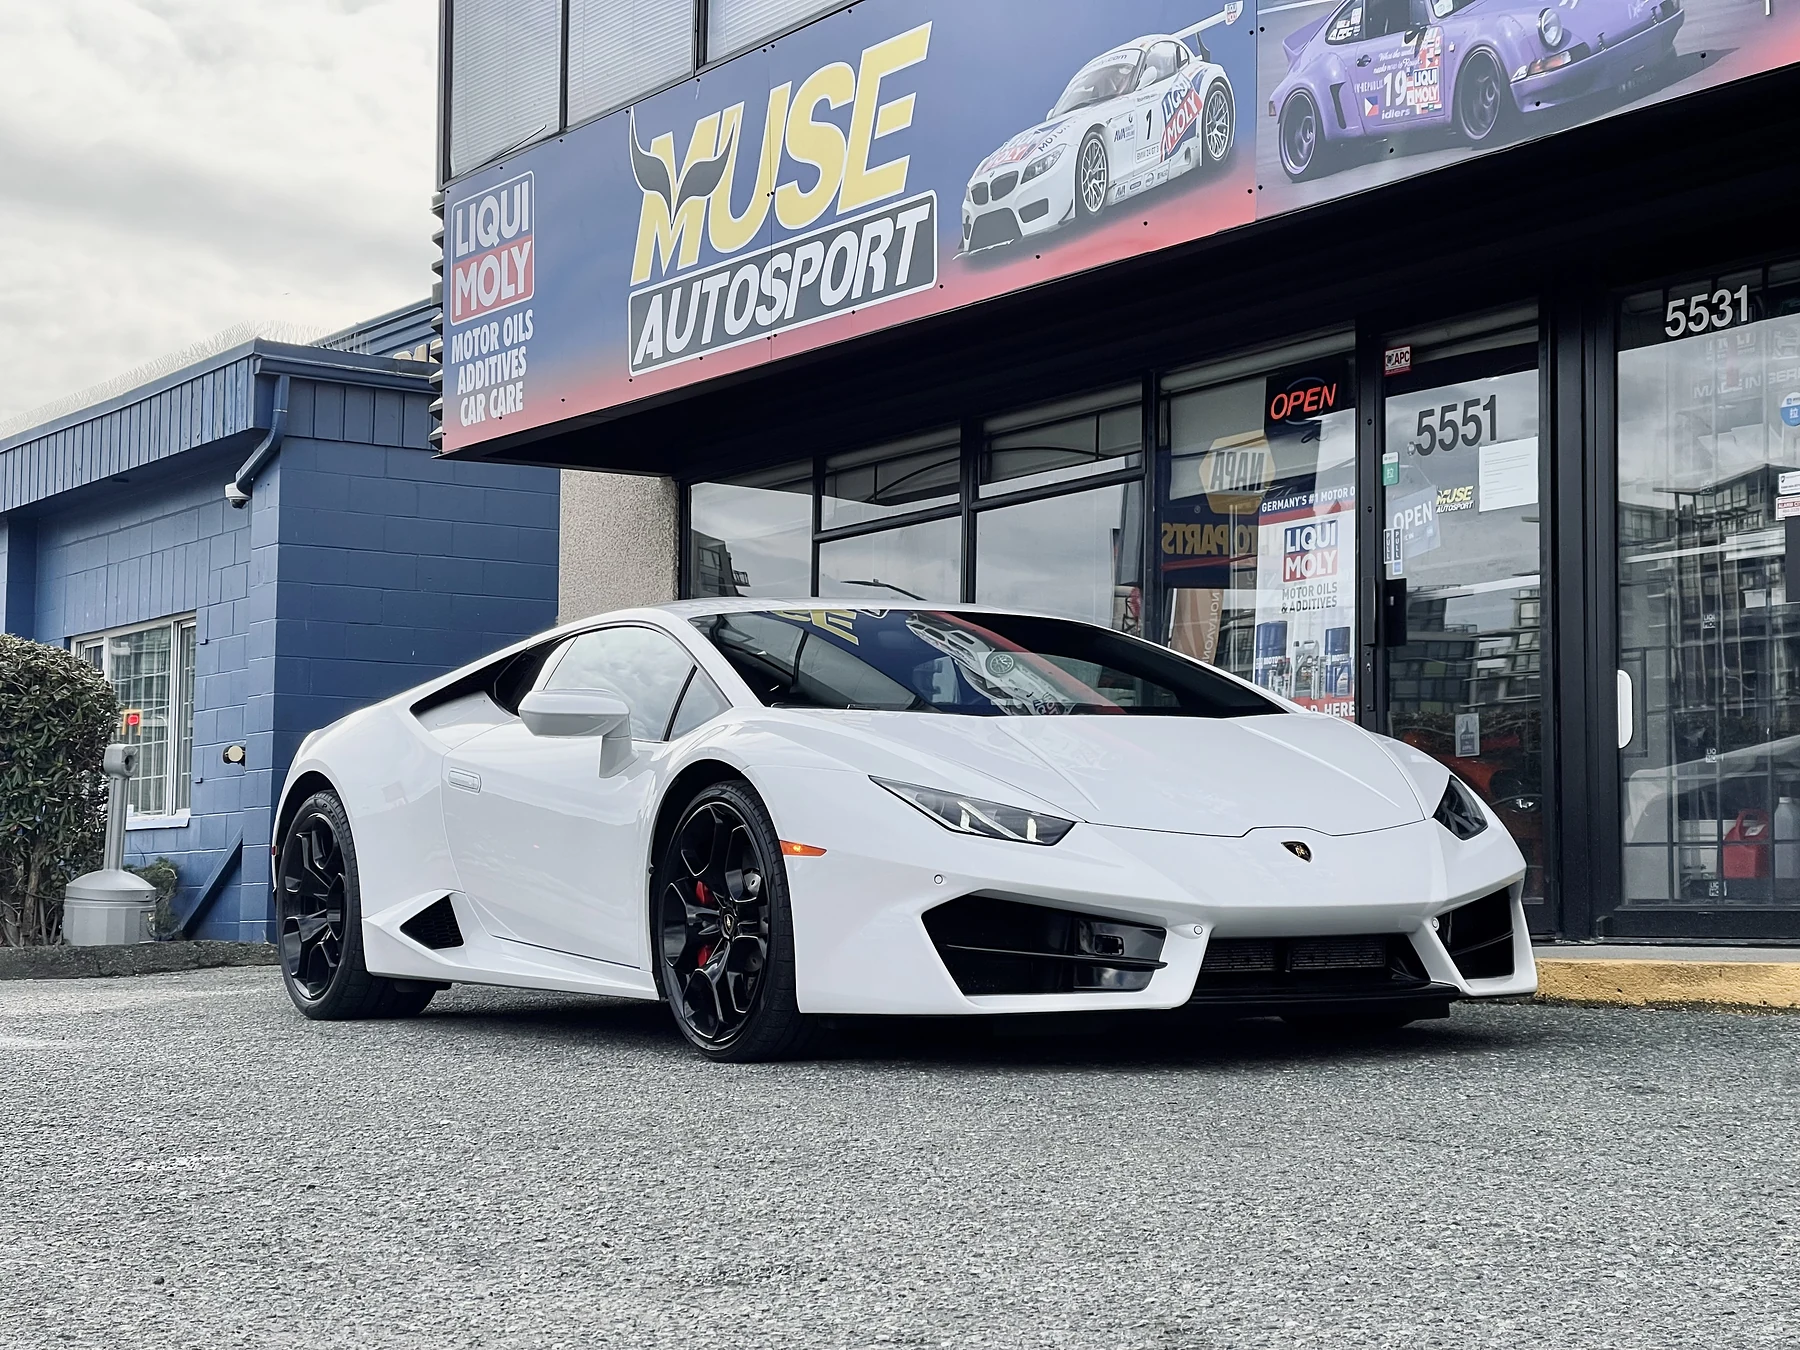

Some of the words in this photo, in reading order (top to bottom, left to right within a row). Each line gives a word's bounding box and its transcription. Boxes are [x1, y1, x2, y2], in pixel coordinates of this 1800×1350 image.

[1384, 70, 1407, 108] 19
[1413, 69, 1438, 87] LIQUI
[1414, 86, 1438, 104] MOLY
[1145, 108, 1153, 141] 1
[1167, 91, 1199, 151] MOLY
[1381, 108, 1411, 120] idlers
[630, 20, 933, 287] MUSE
[456, 181, 529, 258] LIQUI
[455, 240, 532, 317] MOLY
[632, 202, 932, 367] AUTOSPORT
[1664, 284, 1749, 338] 5531
[451, 321, 500, 364] MOTOR
[503, 309, 534, 347] OILS
[457, 346, 527, 396] ADDITIVES
[1394, 350, 1410, 365] APC
[460, 393, 486, 427] CAR
[489, 381, 524, 419] CARE
[1270, 383, 1337, 421] OPEN
[1415, 394, 1497, 457] 5551
[1262, 495, 1307, 513] GERMANY'S
[1309, 493, 1318, 505] #1
[1321, 487, 1348, 502] MOTOR
[1436, 485, 1474, 505] MUSE
[1436, 501, 1474, 514] AUTOSPORT
[1393, 500, 1433, 530] OPEN
[1286, 521, 1337, 554] LIQUI
[1285, 549, 1338, 580] MOLY
[1281, 605, 1288, 614] &
[1289, 595, 1338, 613] ADDITIVES
[1282, 585, 1314, 601] MOTOR
[1317, 582, 1338, 598] OILS
[1325, 701, 1355, 717] HERE
